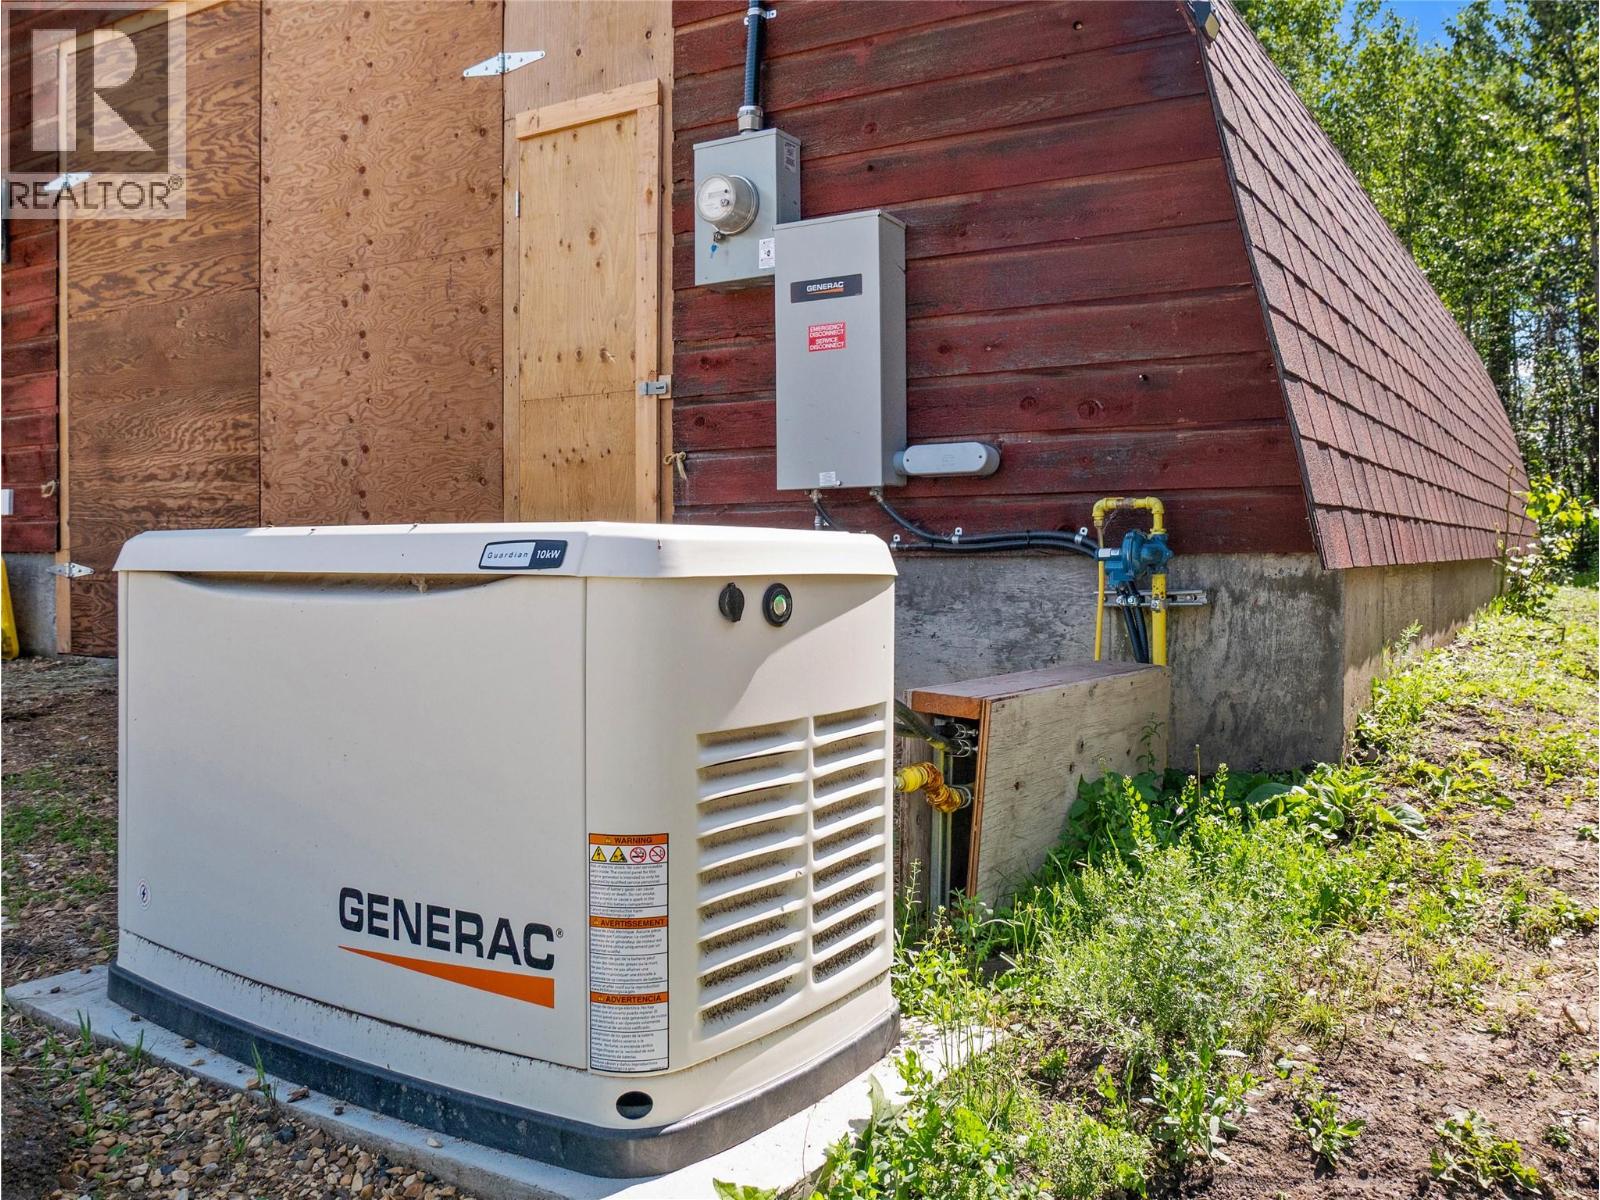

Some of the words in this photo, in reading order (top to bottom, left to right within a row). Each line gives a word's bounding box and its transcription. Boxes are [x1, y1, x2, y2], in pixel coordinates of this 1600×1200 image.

[806, 281, 844, 292] GENERAC
[809, 323, 844, 332] EMERGENCY
[809, 328, 844, 338] DISCONNECT
[815, 336, 838, 345] SERVICE
[809, 341, 844, 351] DISCONNECT
[487, 551, 529, 559] Guardian
[536, 549, 561, 559] 10kW
[614, 836, 653, 844] WARNING
[600, 918, 665, 928] AVERTISSEMENT
[605, 994, 662, 1004] ADVERTENCIA
